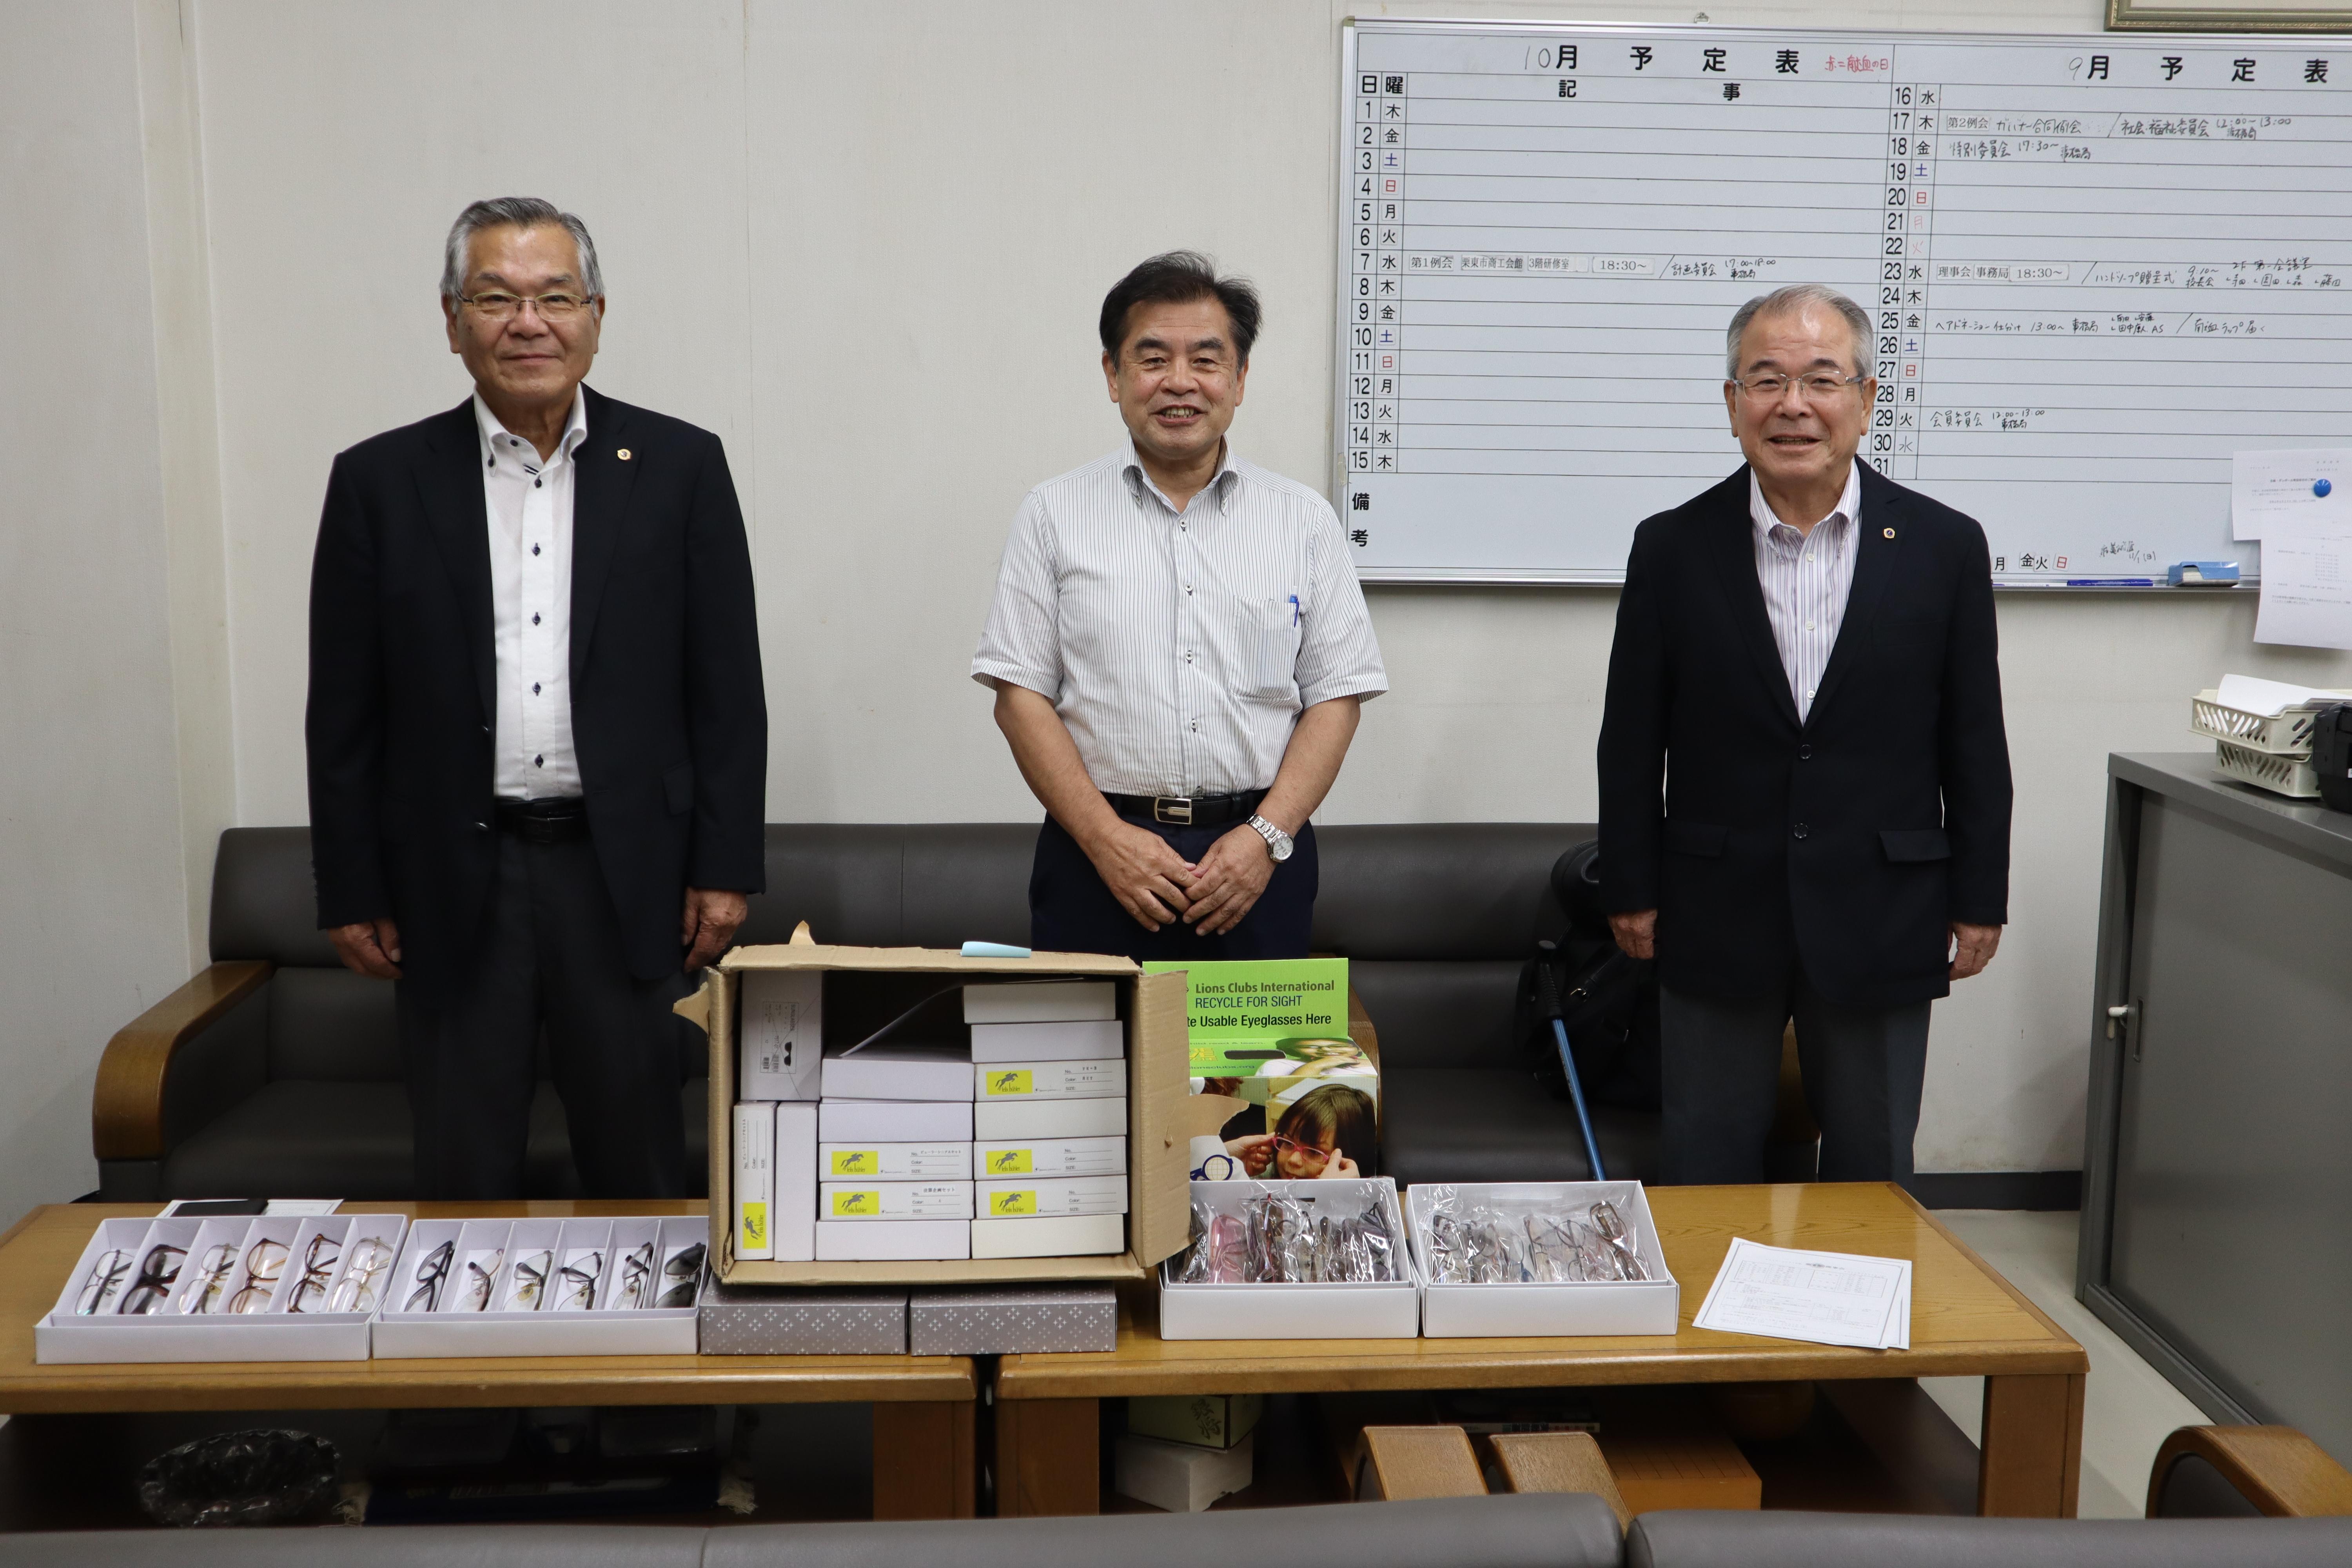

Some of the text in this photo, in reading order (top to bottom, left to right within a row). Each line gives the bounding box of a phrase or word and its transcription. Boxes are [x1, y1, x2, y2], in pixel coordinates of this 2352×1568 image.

[1362, 76, 1740, 101] 日 曜 記 事
[1896, 87, 1935, 105] 16 水
[1366, 101, 1400, 118] 1 木
[1894, 113, 1909, 129] 17
[1919, 116, 1933, 129] 木
[1947, 116, 1988, 130] 第2例会
[1363, 127, 1399, 144] 2 金
[1892, 138, 1906, 155] 18
[1916, 141, 1930, 154] 金
[1363, 152, 1397, 169] 3 土
[1891, 163, 1927, 180] 19 土
[1361, 178, 1396, 195] 4 日
[1888, 188, 1926, 205] 20 日
[1362, 204, 1395, 221] 5 月
[1888, 213, 1902, 230] 21
[1361, 228, 1395, 245] 6 火
[1886, 238, 1902, 254] 22
[1361, 254, 1369, 270] 7
[1382, 255, 1396, 269] 水
[1412, 256, 1453, 268] 第1例会
[1885, 263, 1901, 280] 23
[1909, 265, 1922, 279] 水
[1938, 267, 1970, 277] 理事会
[1978, 267, 2008, 278] 事務局
[1360, 278, 1394, 295] 8 木
[1883, 287, 1921, 304] 24 木
[1360, 303, 1395, 320] 9 金
[1882, 312, 1898, 329] 25
[1907, 314, 1920, 327] 金
[1356, 328, 1393, 345] 10 土
[1880, 337, 1918, 354] 26 土
[1356, 353, 1392, 369] 11 日
[1879, 361, 1915, 378] 27 日
[1355, 377, 1391, 394] 12 月
[1877, 385, 1914, 402] 28 月
[1354, 402, 1392, 419] 13 火
[1876, 410, 1893, 426] 29
[1900, 413, 1912, 426] 火
[1353, 427, 1391, 443] 14 水
[1875, 434, 1913, 452] 30 水
[1353, 452, 1392, 468] 15 木
[1874, 458, 1888, 475] 31
[1995, 554, 2067, 570] 月 金 火 日
[1196, 980, 1334, 993] Lions Clubs International
[1196, 996, 1302, 1008] RECYCLE FOR SIGHT
[1201, 1015, 1237, 1027] Usable
[1241, 1014, 1302, 1028] Eyeglasses
[1306, 1014, 1331, 1024] Here
